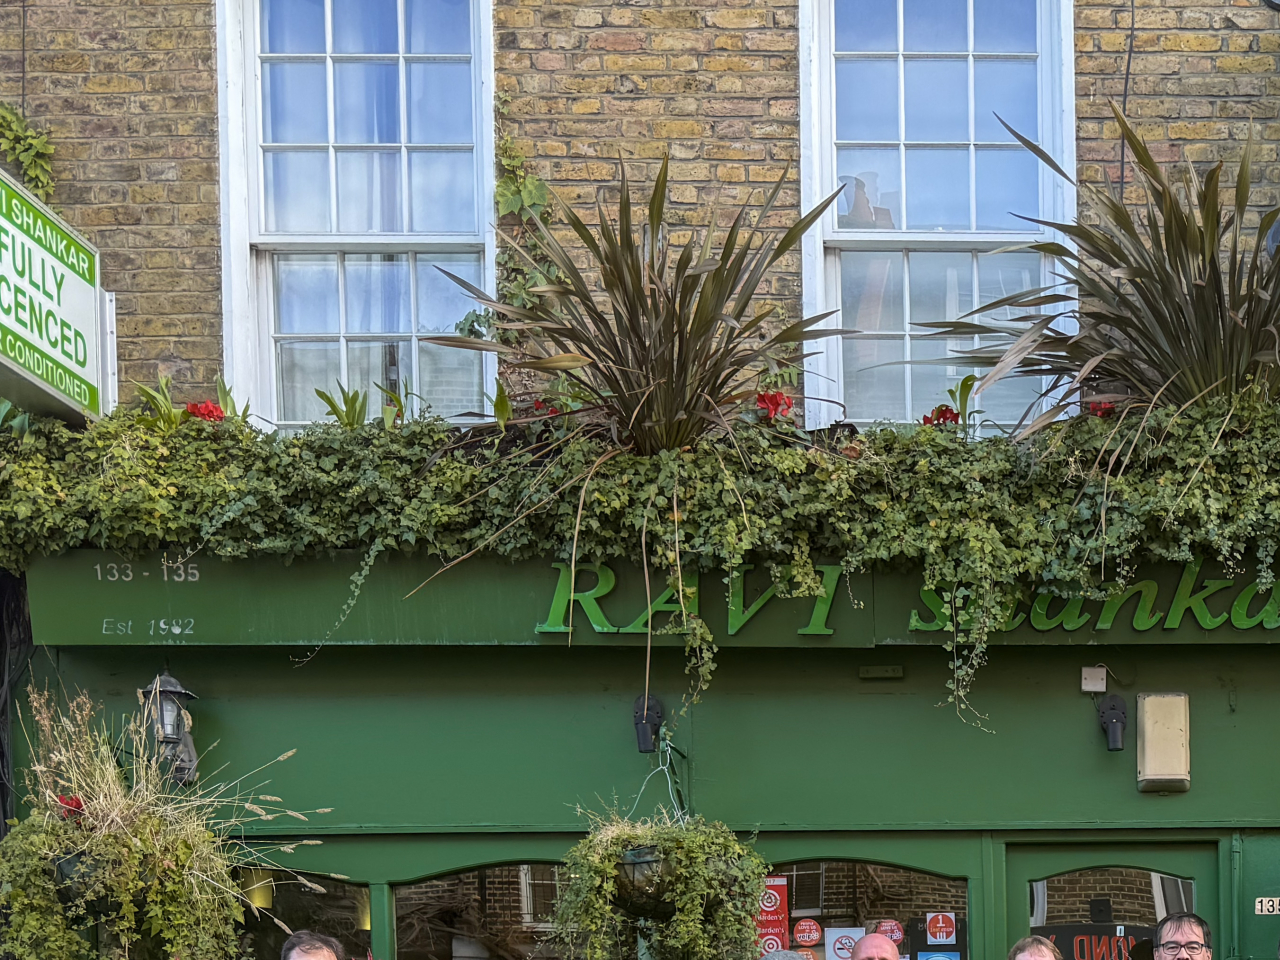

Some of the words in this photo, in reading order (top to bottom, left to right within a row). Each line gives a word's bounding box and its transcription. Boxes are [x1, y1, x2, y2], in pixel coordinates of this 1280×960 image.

[0, 224, 65, 307] FULLY
[11, 198, 90, 280] SHANKAR
[6, 334, 90, 407] CONDITIONED
[93, 563, 134, 581] 133
[161, 563, 200, 582] 135
[534, 562, 844, 636] RAVI
[102, 618, 133, 635] Est
